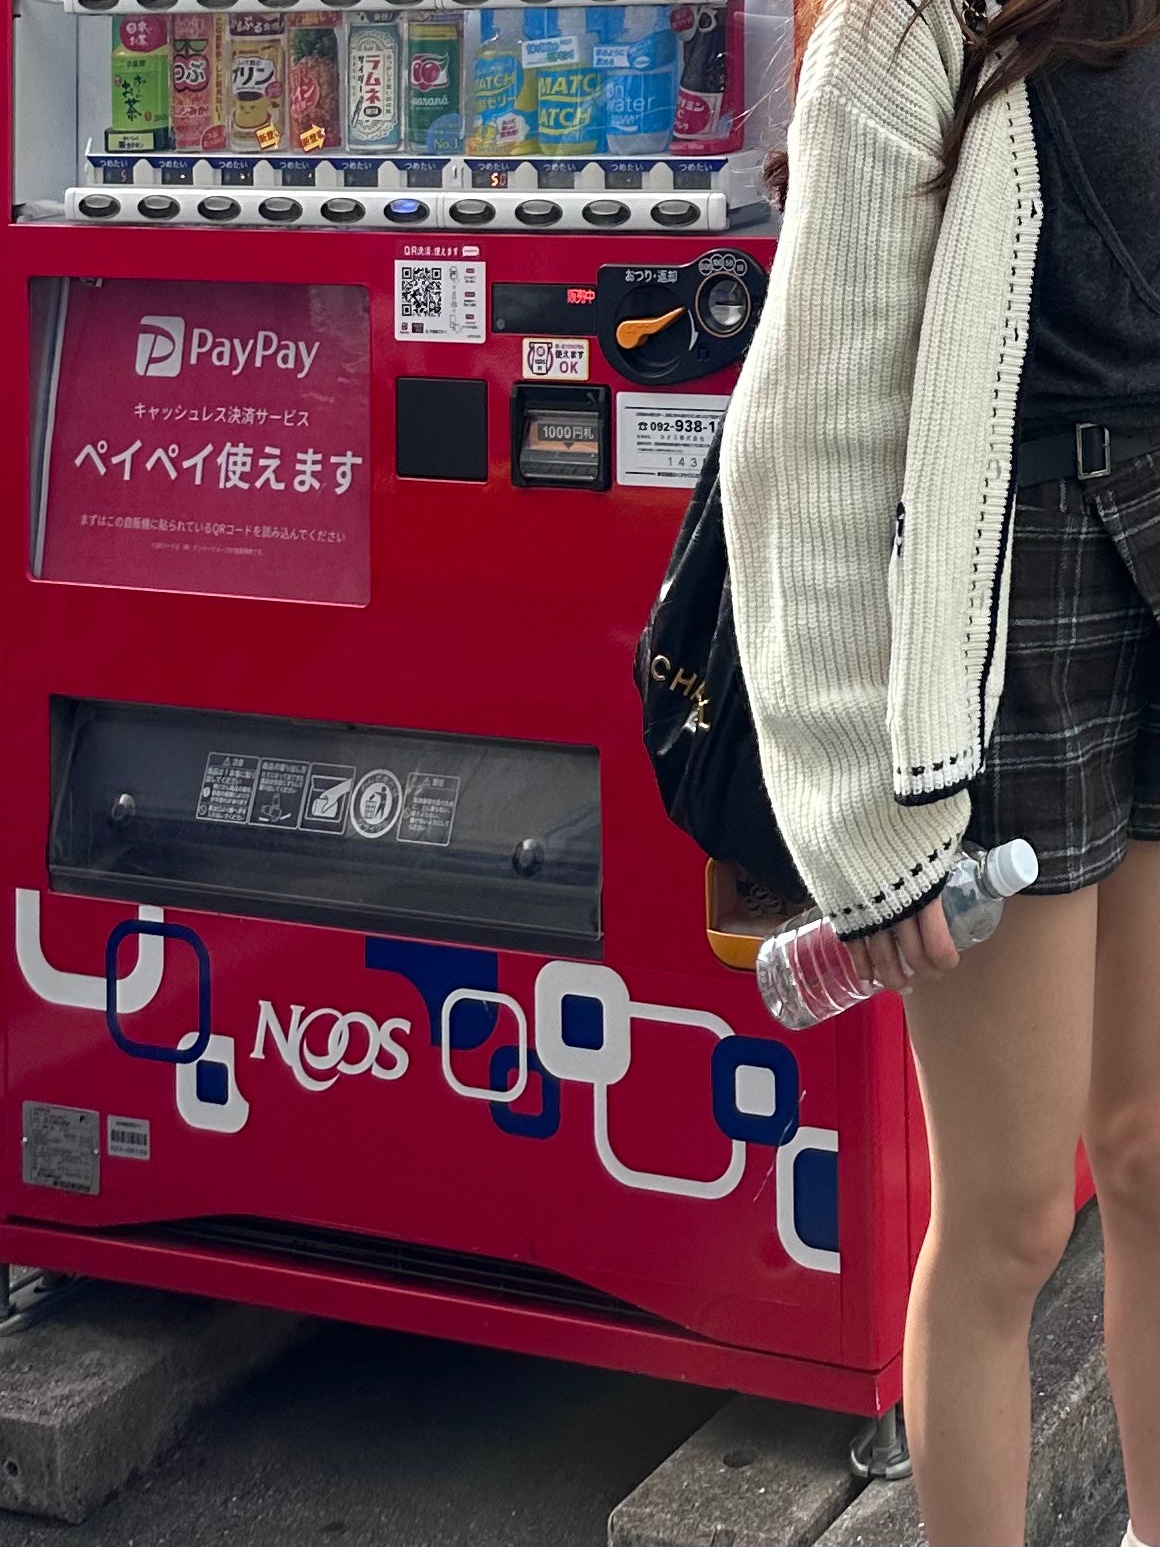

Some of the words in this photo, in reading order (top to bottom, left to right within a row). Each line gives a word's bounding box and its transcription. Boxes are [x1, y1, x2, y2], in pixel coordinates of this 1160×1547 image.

[365, 55, 382, 105] ラムネ
[475, 71, 515, 92] ATCH
[539, 73, 601, 95] MATC
[539, 107, 593, 127] ATCH
[100, 159, 128, 168] つめたい
[158, 160, 187, 168] つめたい
[218, 160, 248, 168] つめたい
[279, 161, 310, 170] つめたい
[342, 162, 371, 170] つめたい
[405, 162, 437, 170] つめたい
[477, 163, 509, 172] つめたい
[543, 163, 576, 172] つめたい
[611, 163, 644, 172] つめたい
[679, 163, 713, 172] つめたい
[566, 288, 596, 304] 販売中
[190, 327, 320, 379] PayPay
[559, 360, 580, 374] OK
[134, 401, 310, 428] キャッシュレス決済サービス
[542, 424, 595, 441] 1000円札
[74, 438, 363, 495] ペイペイ使えます
[250, 1000, 411, 1091] NOOS
